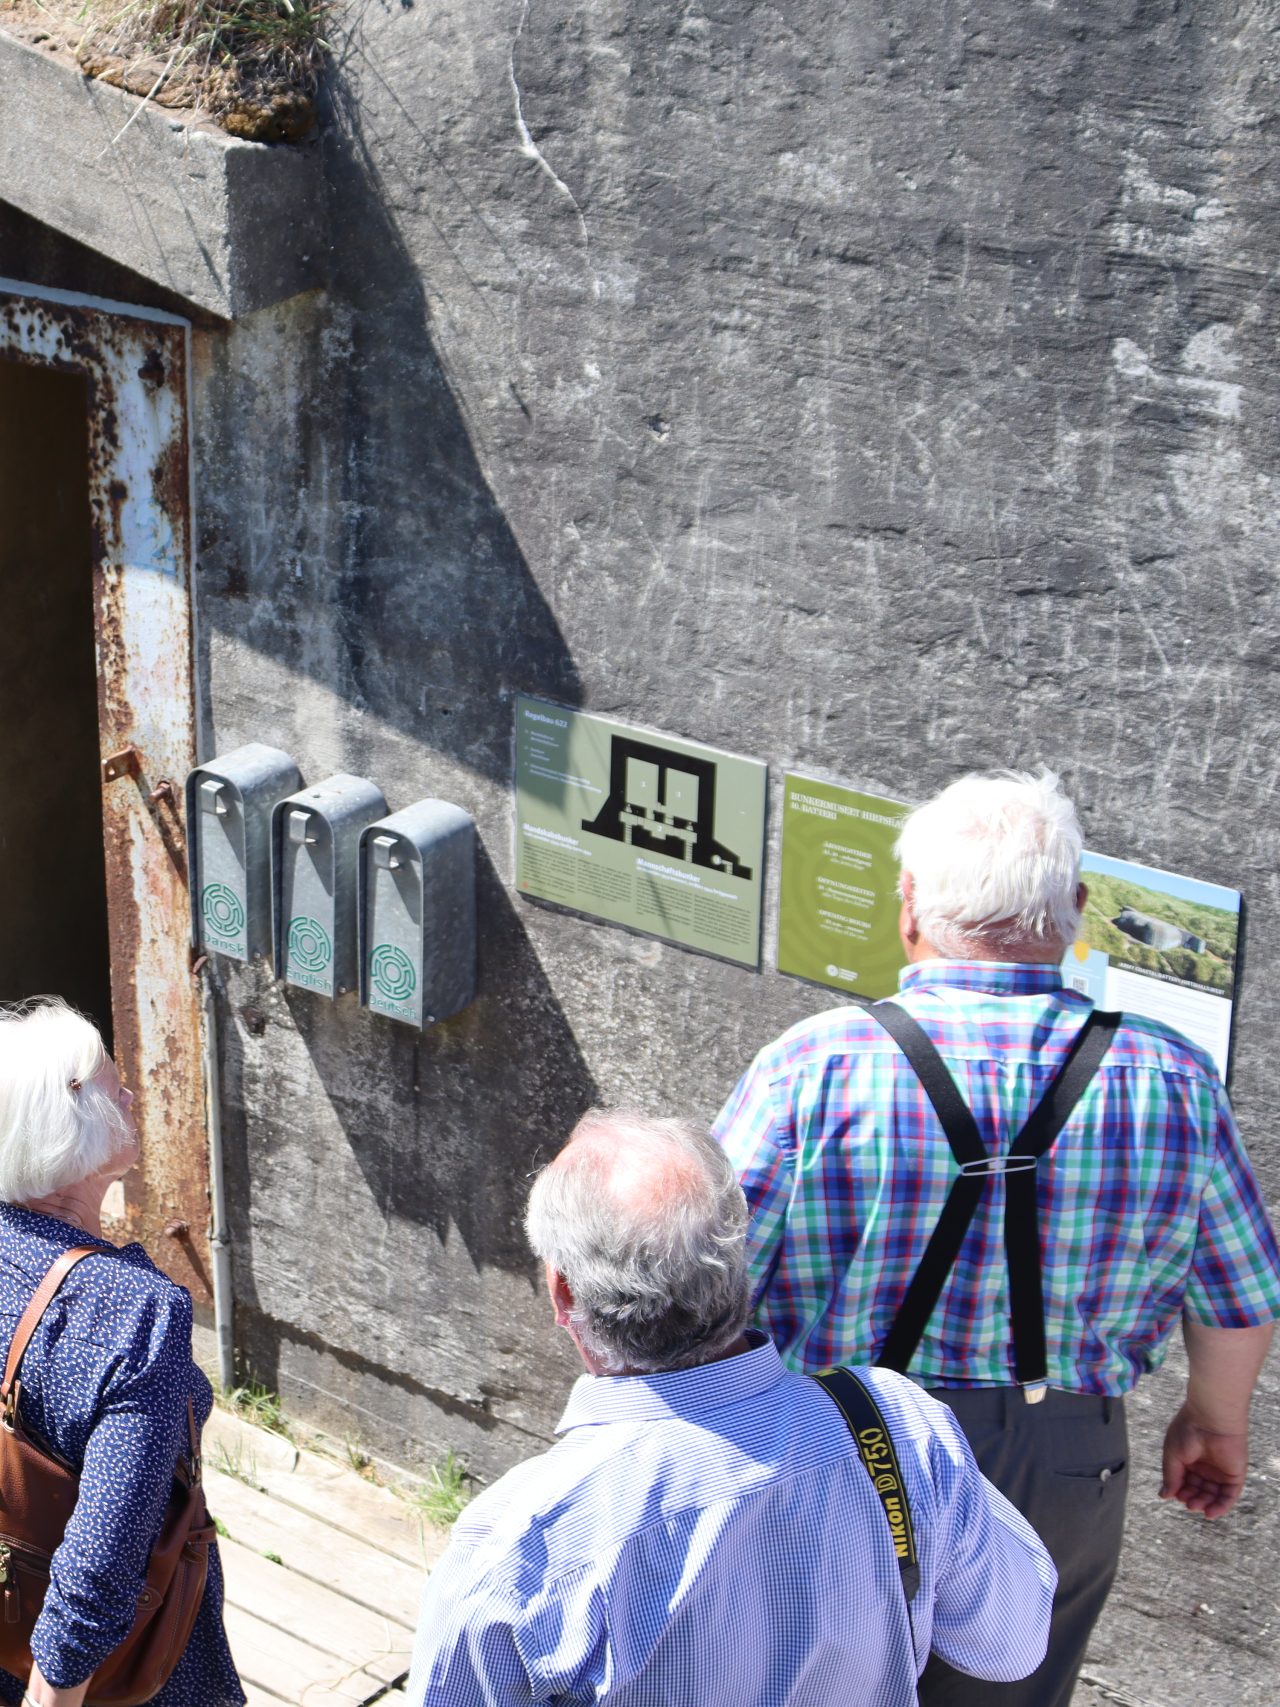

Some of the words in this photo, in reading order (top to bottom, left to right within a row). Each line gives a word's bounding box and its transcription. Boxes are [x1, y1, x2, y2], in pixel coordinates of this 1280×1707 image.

[790, 792, 860, 817] BUNKERMUSEET
[203, 932, 245, 956] Dansk
[286, 965, 332, 991] English
[368, 992, 417, 1019] Deutsch
[859, 1427, 898, 1495] D750
[886, 1497, 909, 1558] Nikon
